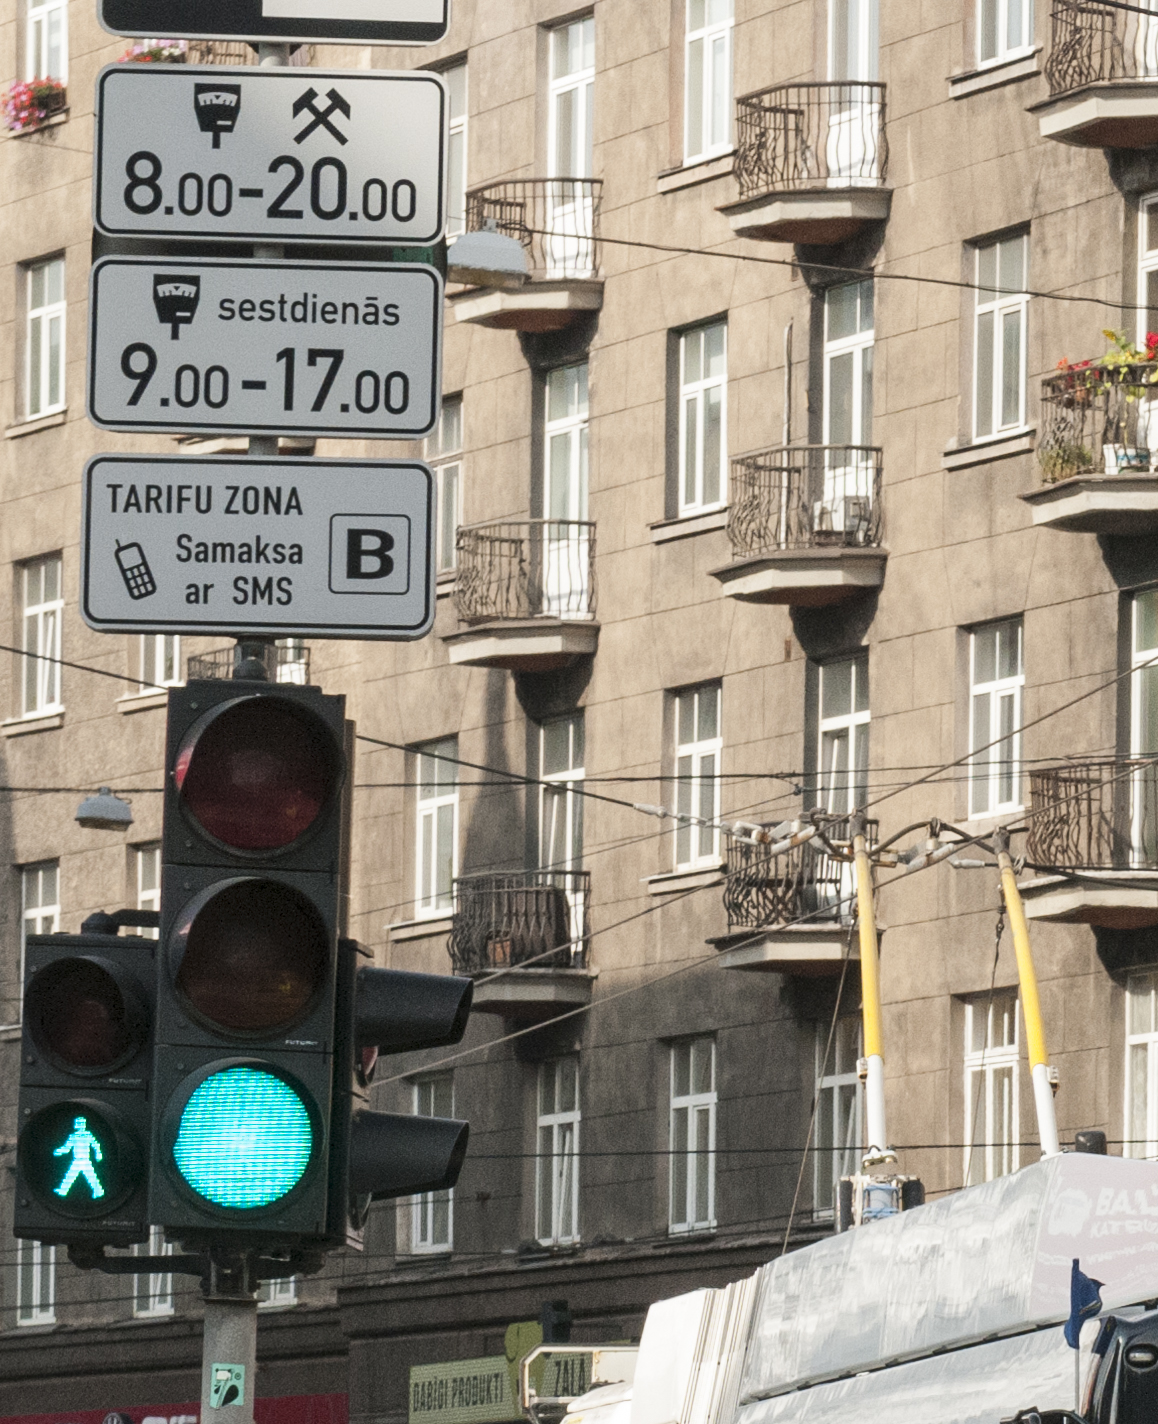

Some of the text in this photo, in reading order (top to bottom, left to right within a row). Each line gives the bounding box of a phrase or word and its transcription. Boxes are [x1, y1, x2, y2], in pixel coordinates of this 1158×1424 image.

[217, 291, 401, 327] sestdienās
[106, 483, 304, 515] TARIFU ZONA
[175, 533, 304, 565] Samaksa
[346, 528, 395, 580] B
[185, 576, 293, 606] ar SMS
[451, 1372, 504, 1408] PRODUKTI
